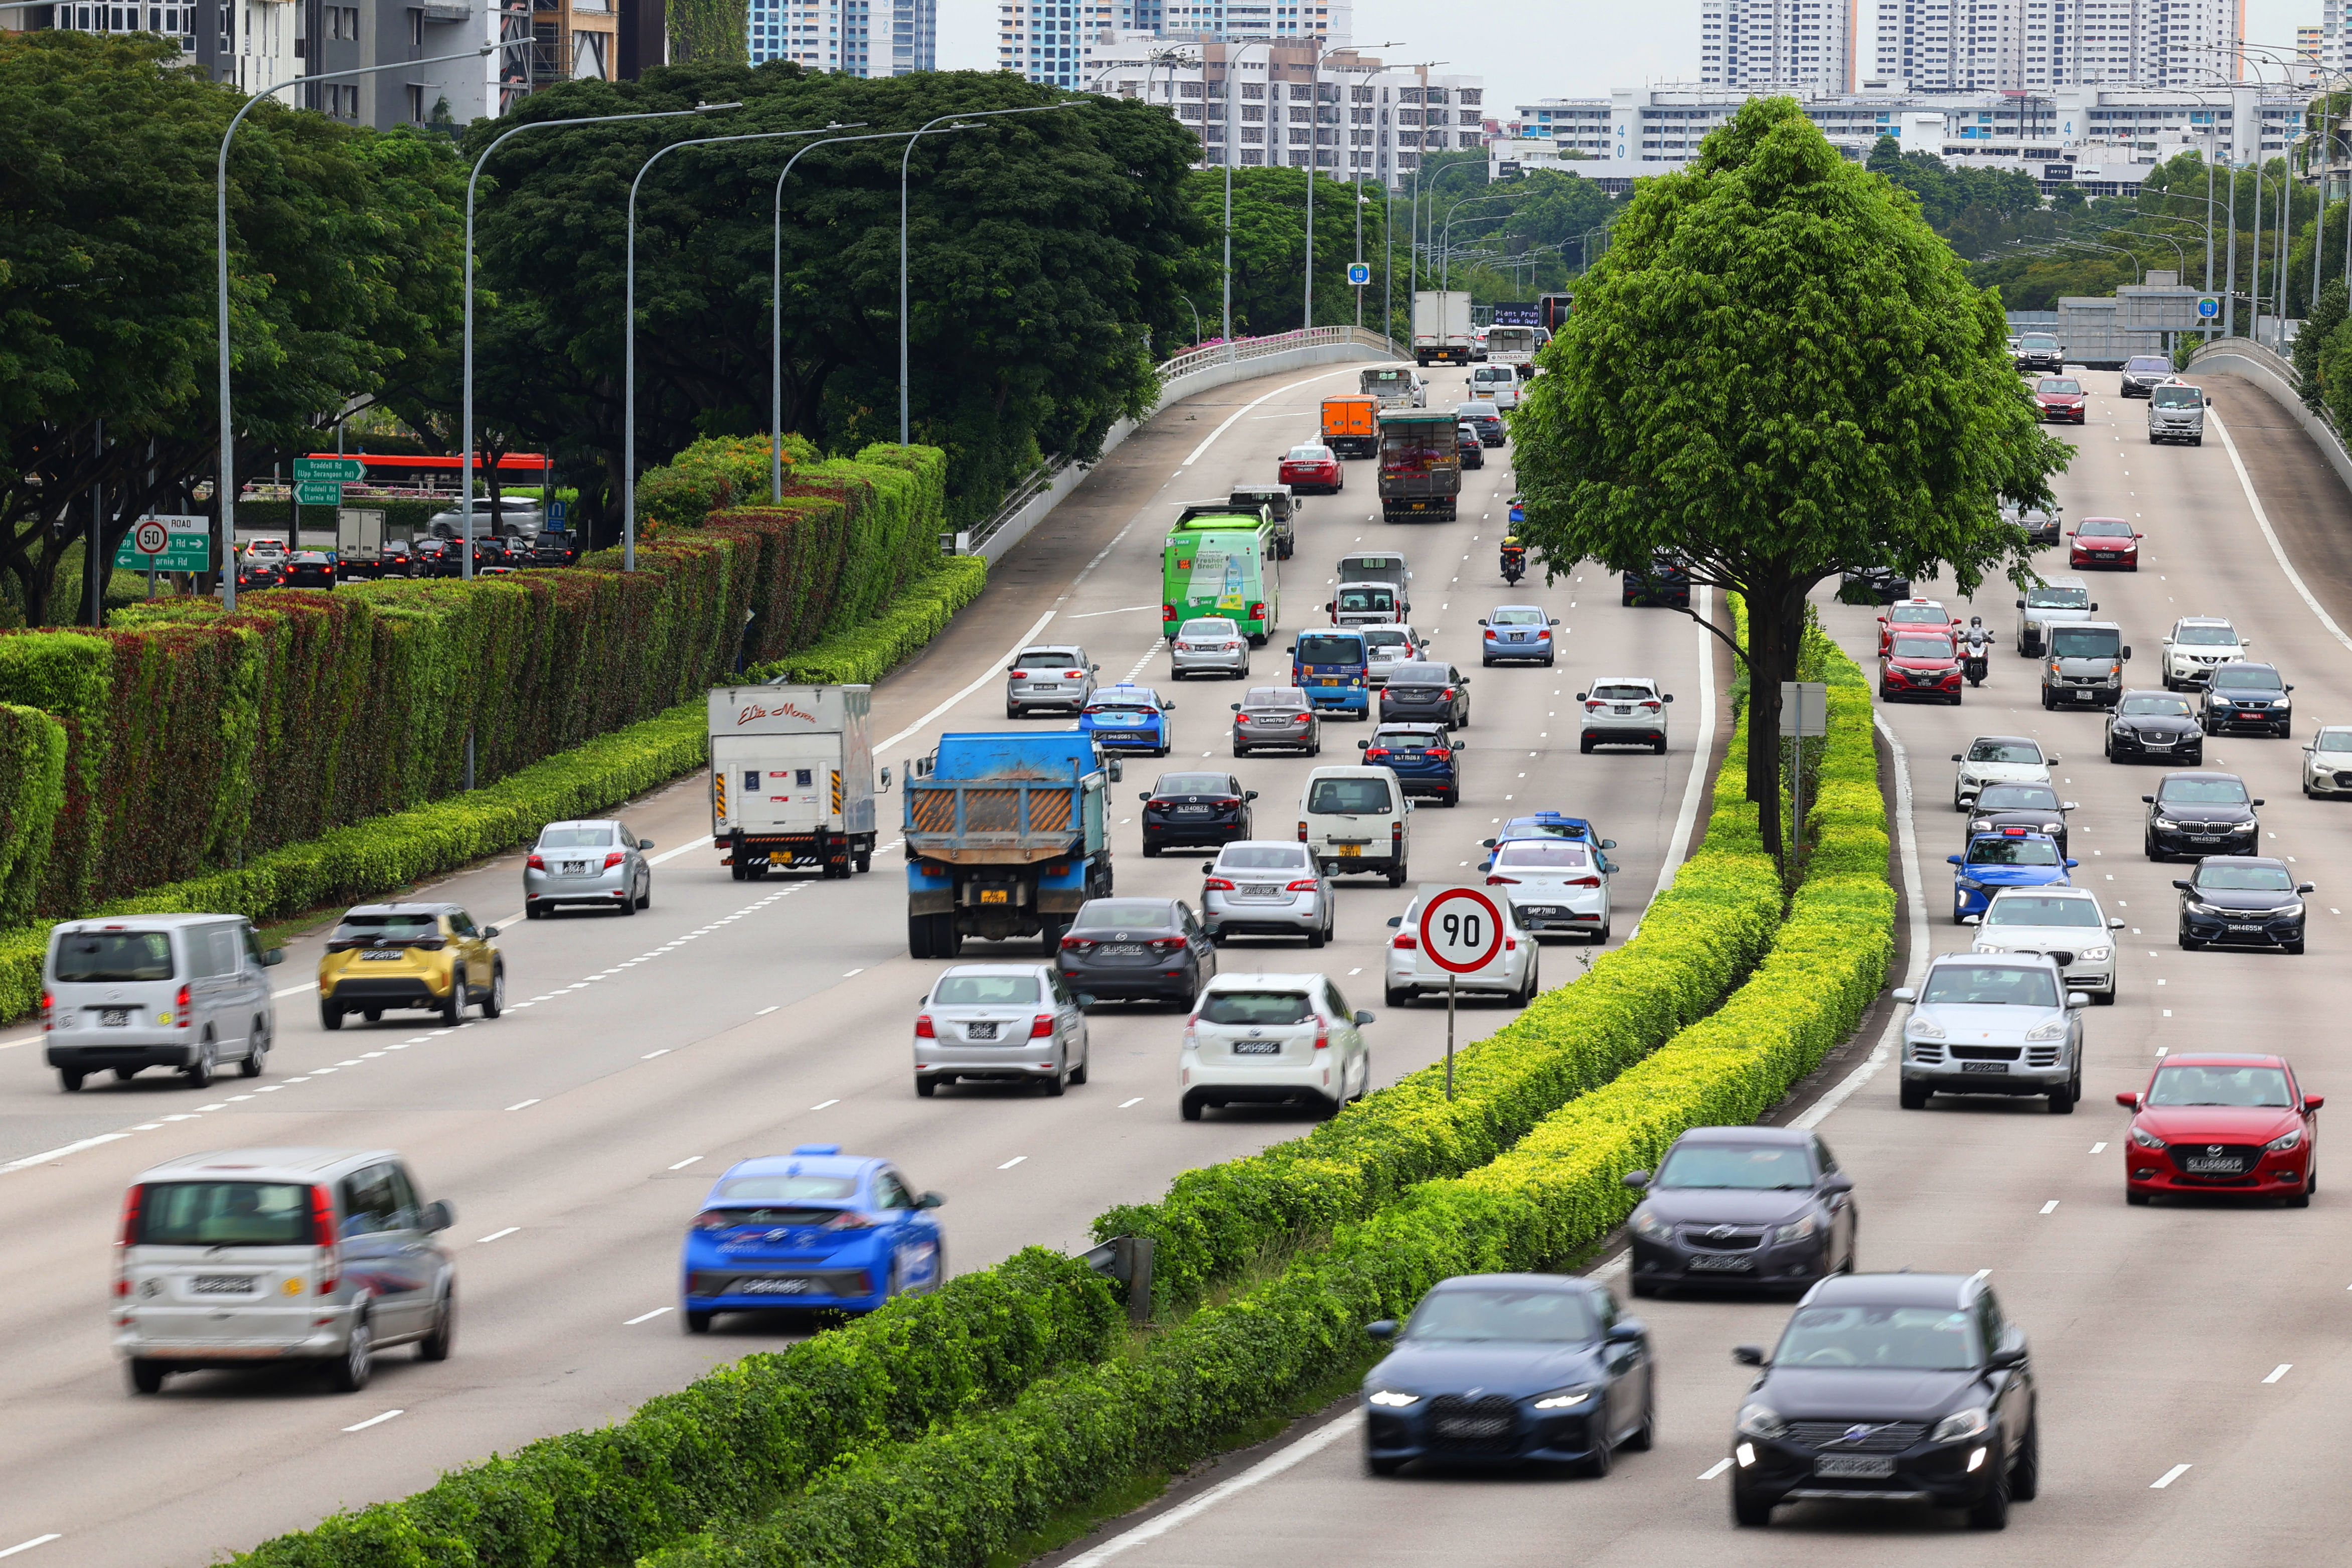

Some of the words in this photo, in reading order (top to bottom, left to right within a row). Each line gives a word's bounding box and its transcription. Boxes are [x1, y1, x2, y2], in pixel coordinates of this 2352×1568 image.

[1355, 270, 1363, 278] 10
[2205, 304, 2212, 312] 10
[298, 469, 311, 479] (Upp
[304, 493, 324, 501] (Lornie
[171, 520, 191, 528] ROAD
[144, 531, 159, 544] 50
[176, 539, 186, 548] Rd
[155, 556, 174, 566] ornie
[178, 557, 187, 566] Rd
[1443, 914, 1480, 947] 90
